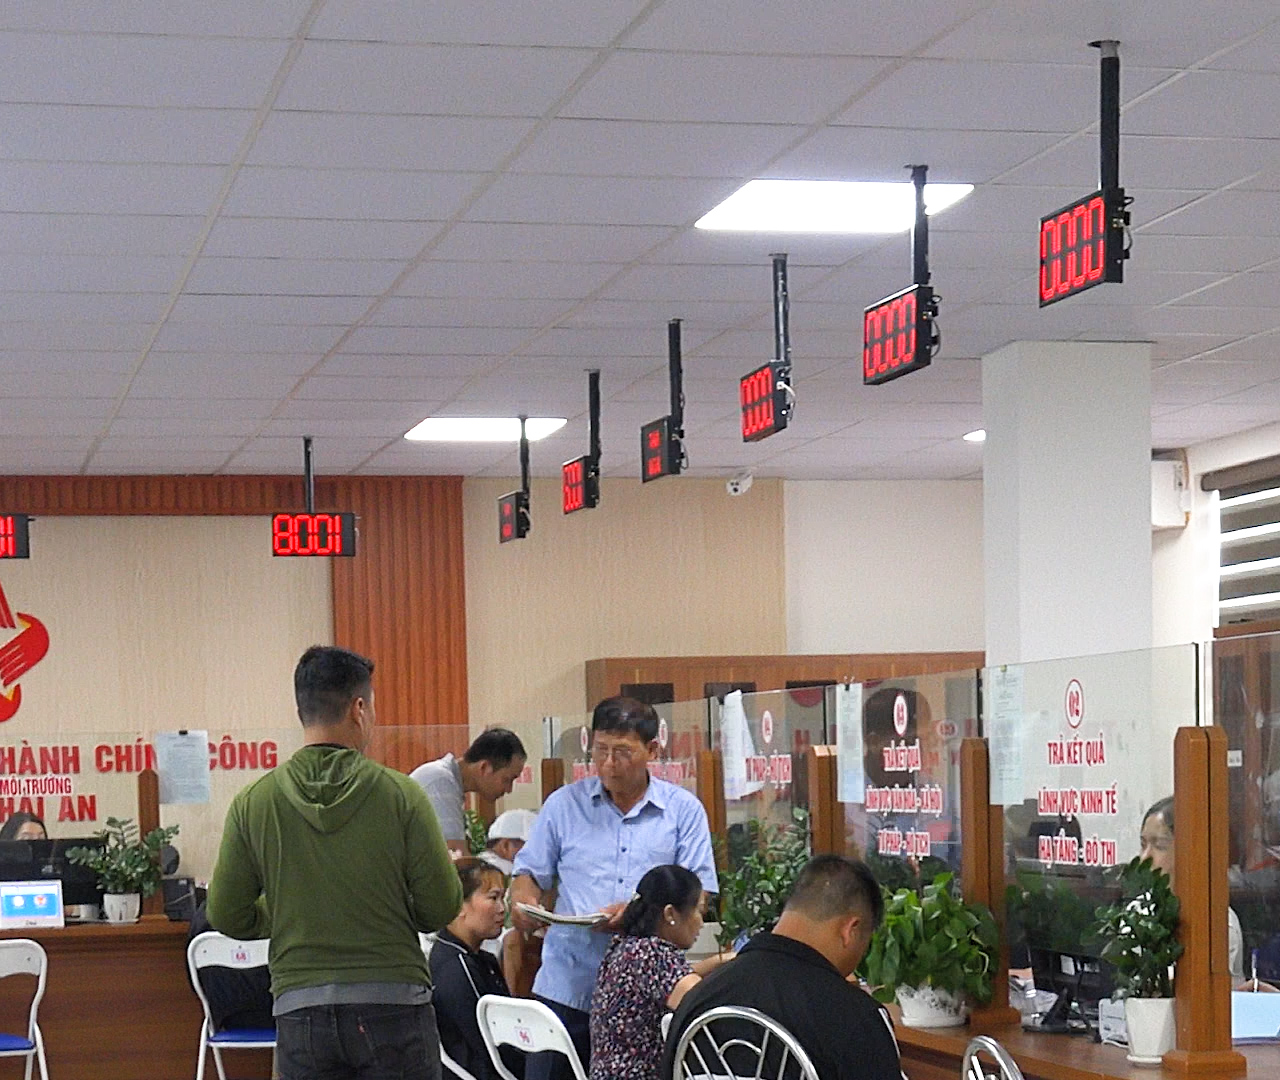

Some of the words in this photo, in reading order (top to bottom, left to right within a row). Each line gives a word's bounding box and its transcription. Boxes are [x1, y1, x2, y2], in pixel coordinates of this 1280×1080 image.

[1040, 195, 1105, 301] 0000
[272, 513, 343, 556] 8001
[1047, 733, 1065, 765] TRẢ
[1066, 733, 1083, 765] KẾT
[1085, 731, 1105, 767] QUẢ
[0, 777, 22, 796] MÔI
[1080, 789, 1103, 814] KINH
[1105, 781, 1117, 814] TẾ
[59, 795, 97, 822] AN
